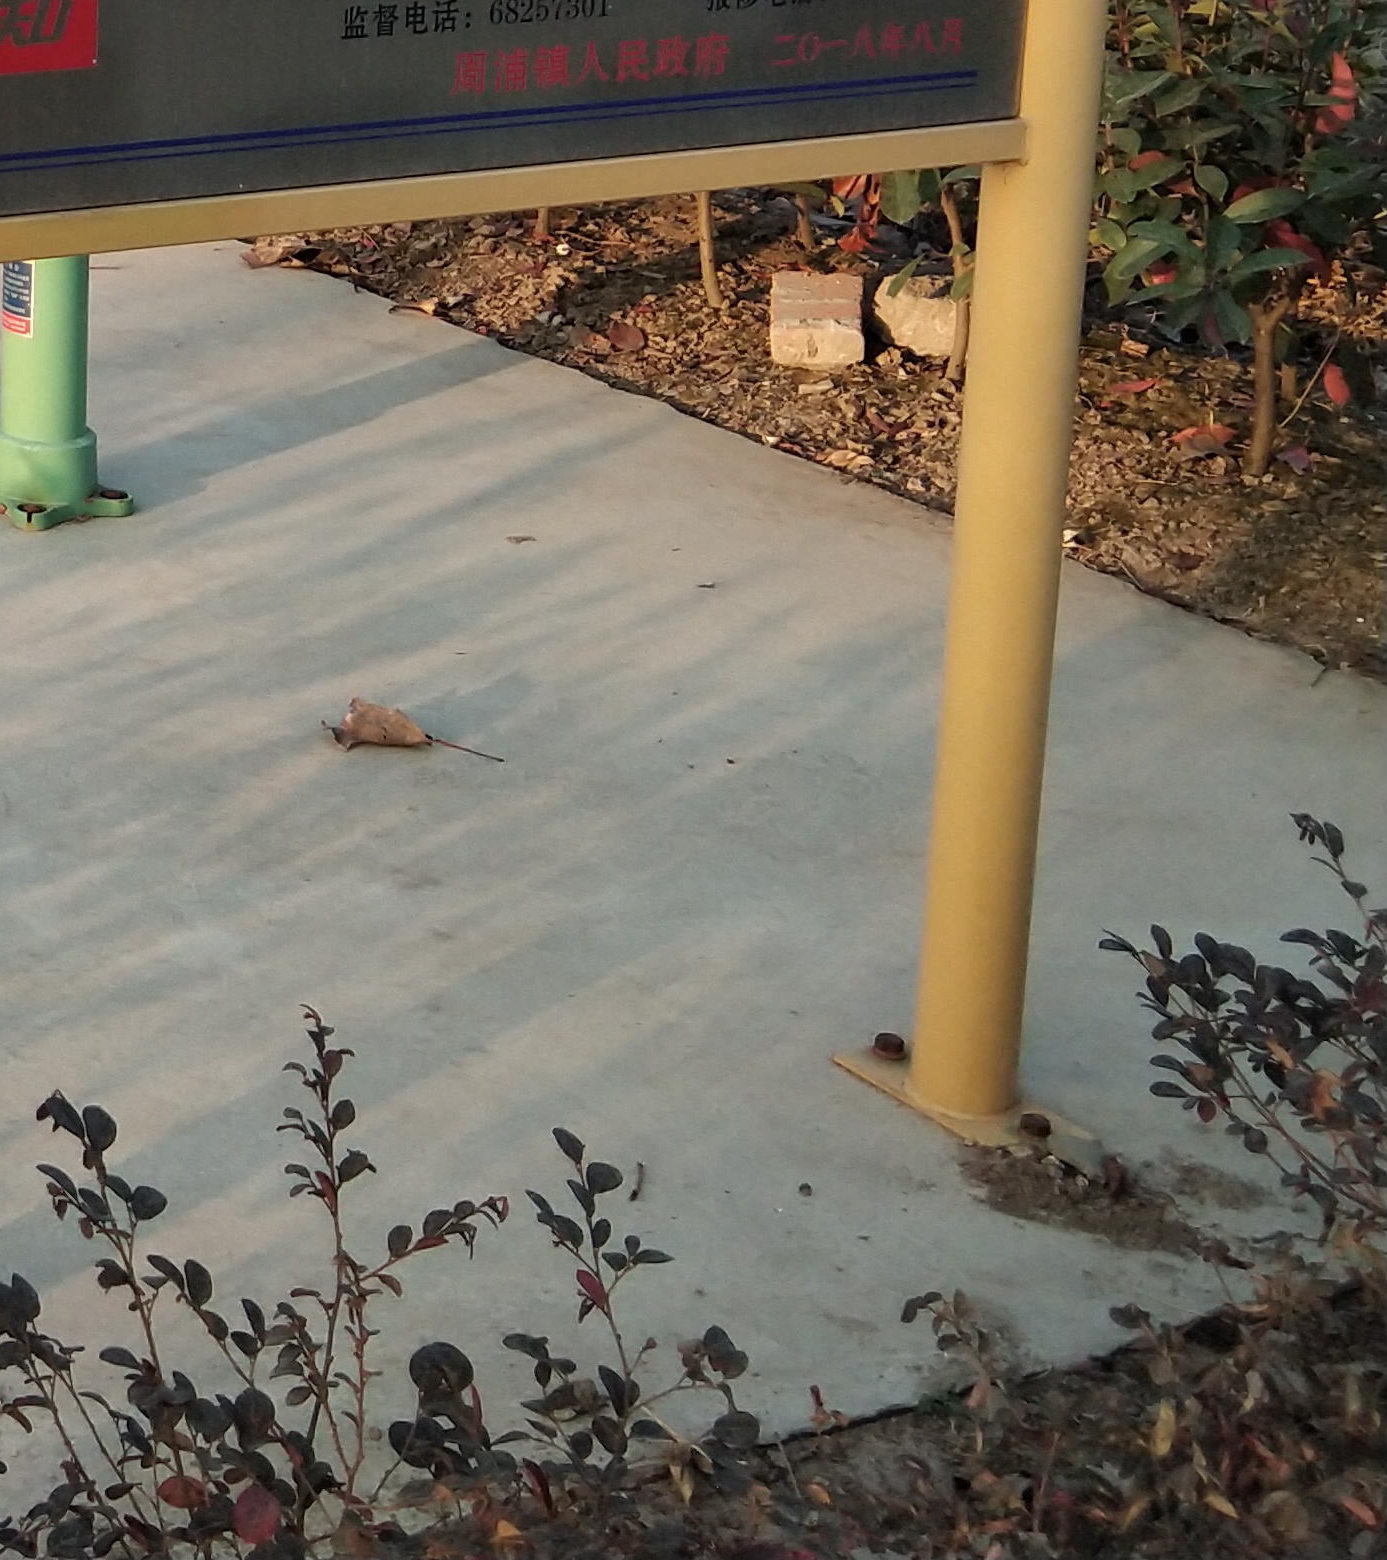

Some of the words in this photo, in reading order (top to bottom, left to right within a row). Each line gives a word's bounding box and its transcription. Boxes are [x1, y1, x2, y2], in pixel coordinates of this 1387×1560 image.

[450, 30, 731, 96] 周浦镇人民政府
